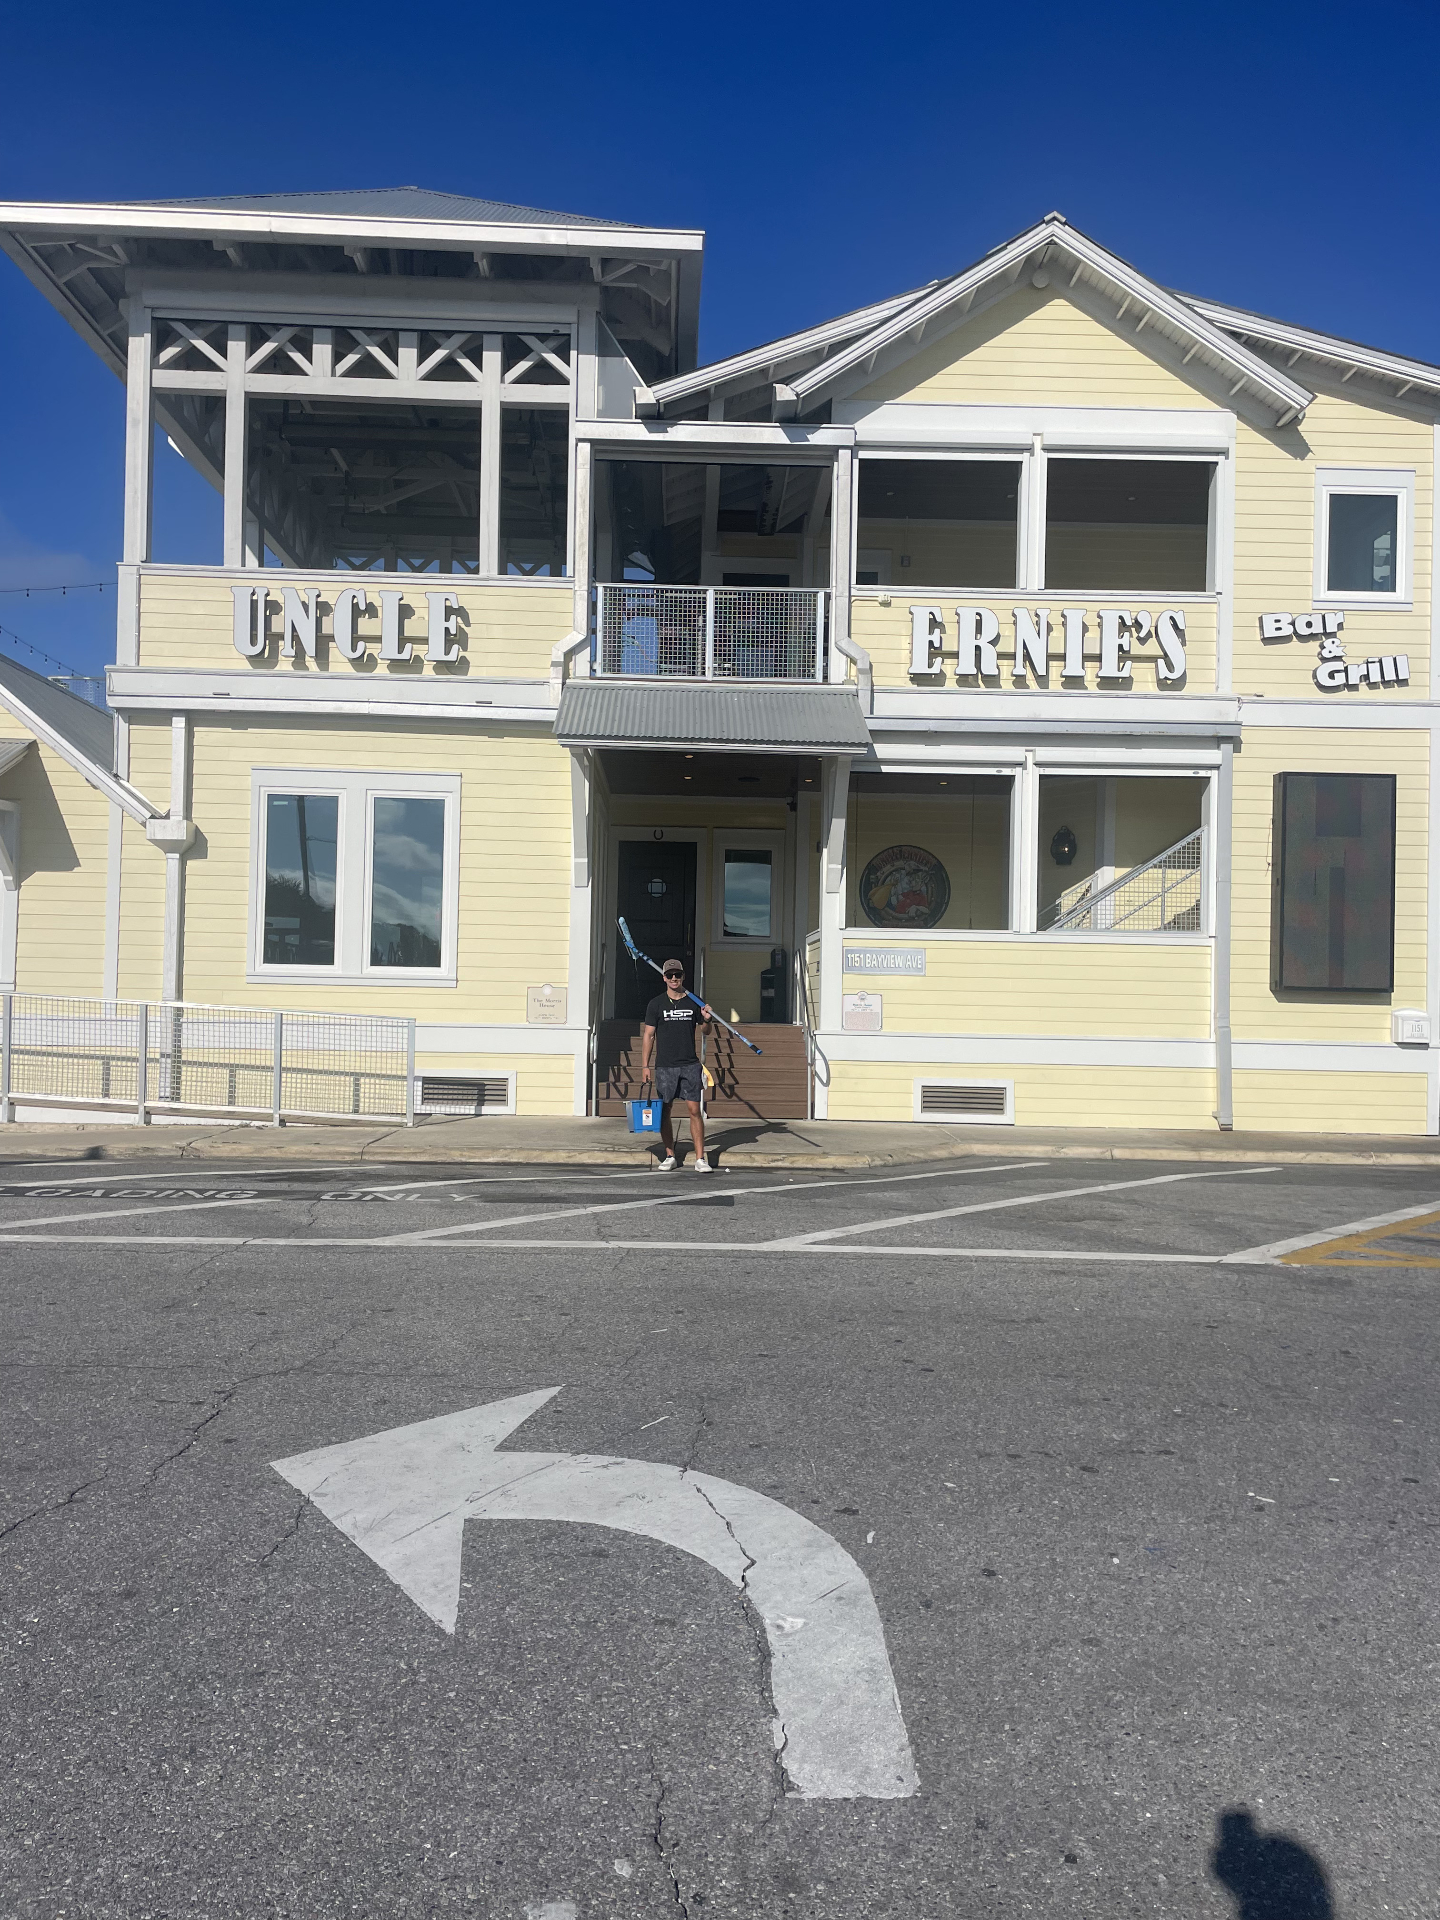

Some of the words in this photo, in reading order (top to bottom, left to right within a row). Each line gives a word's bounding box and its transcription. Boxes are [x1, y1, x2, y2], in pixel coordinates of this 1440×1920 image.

[231, 585, 461, 662] UNCLE
[1259, 611, 1345, 640] Bar
[908, 605, 1187, 680] ERNIE'S
[1319, 637, 1347, 659] &
[1313, 654, 1411, 688] Grill
[847, 953, 864, 967] 1151
[865, 953, 903, 968] BAYVIEW
[905, 954, 922, 969] AVE
[663, 1009, 694, 1018] HSP
[320, 1191, 480, 1202] ONLY
